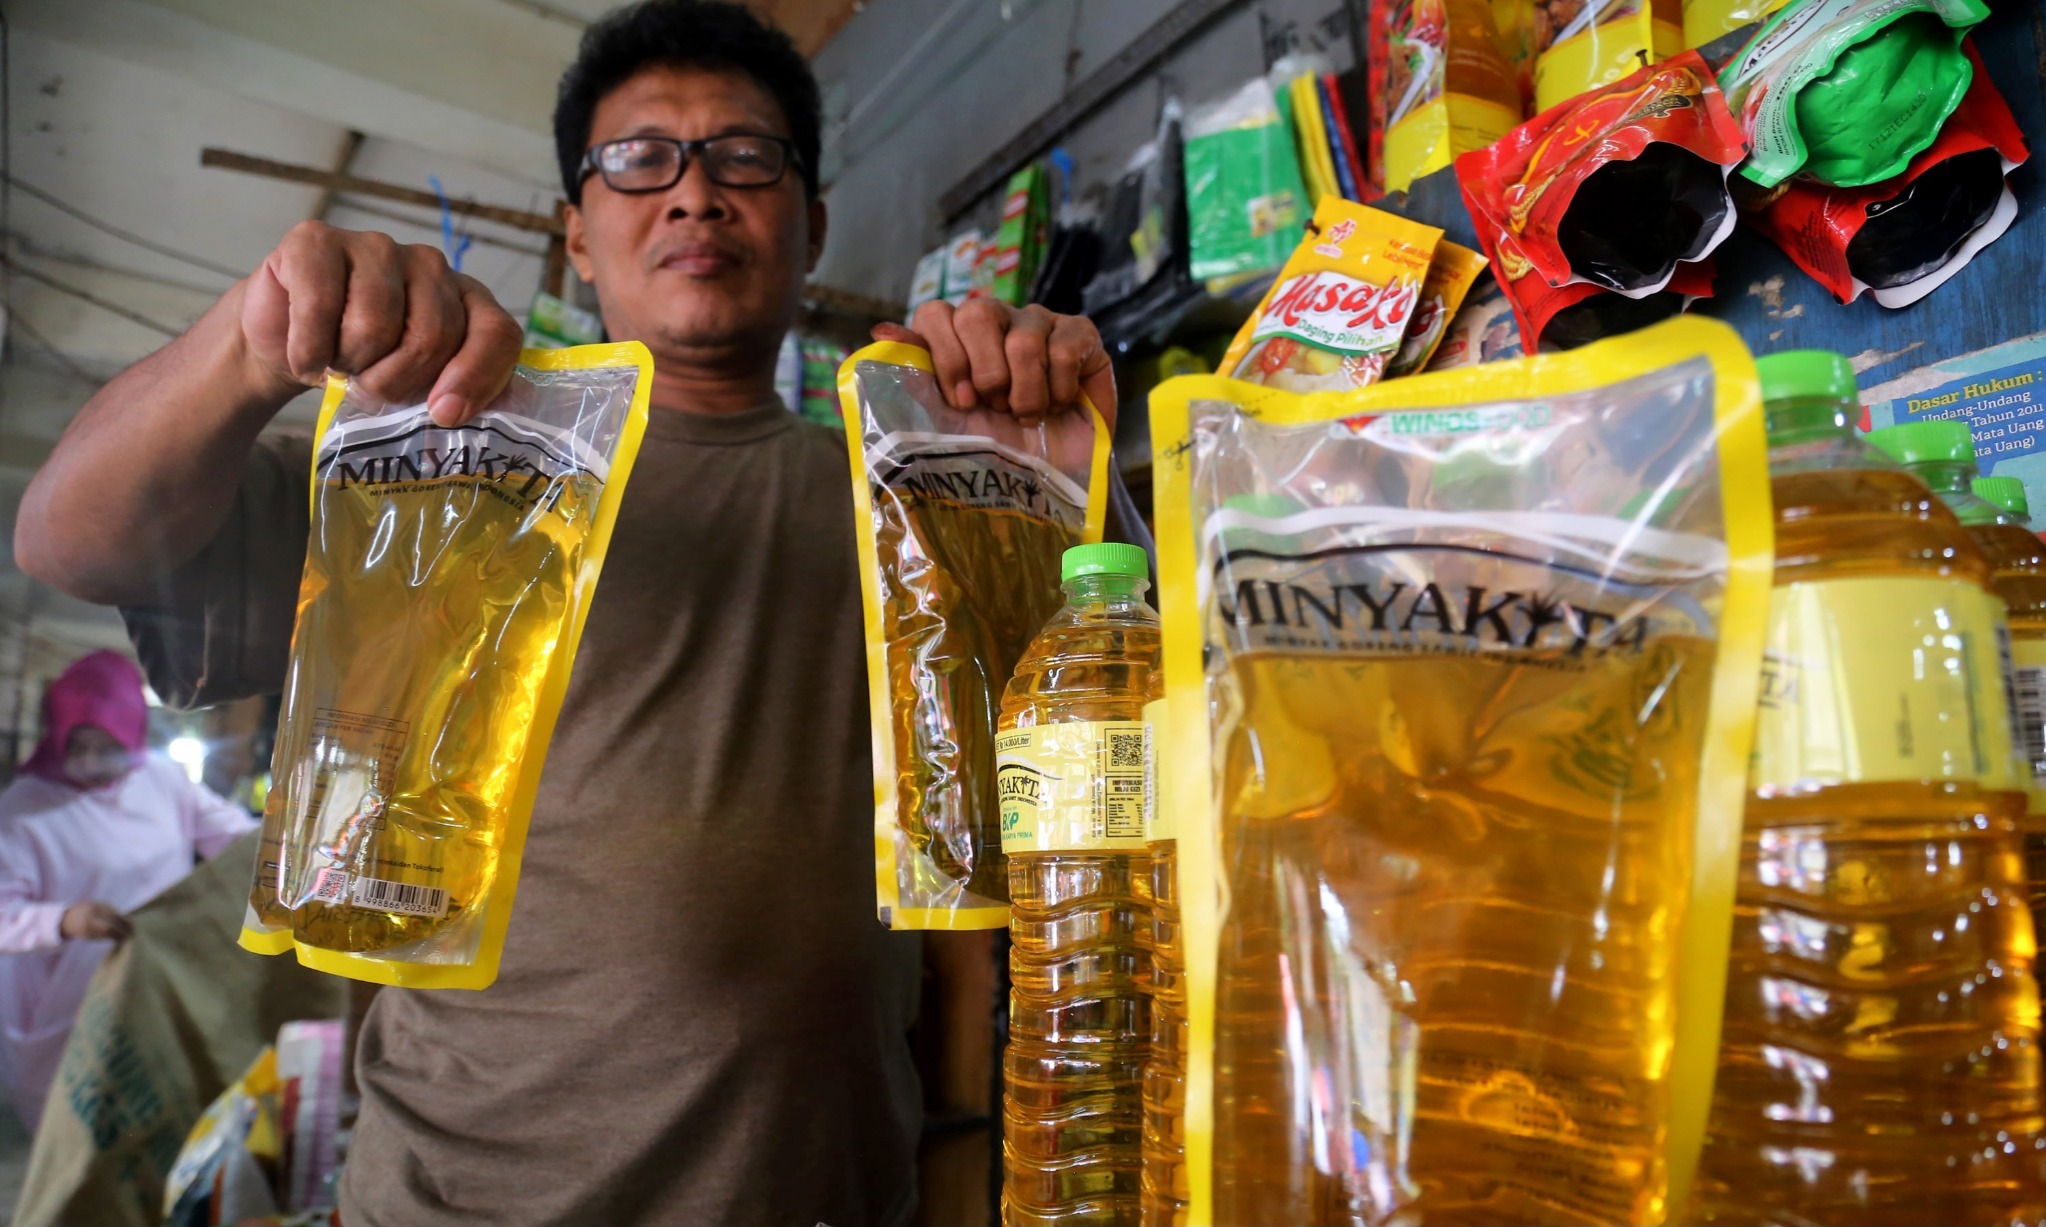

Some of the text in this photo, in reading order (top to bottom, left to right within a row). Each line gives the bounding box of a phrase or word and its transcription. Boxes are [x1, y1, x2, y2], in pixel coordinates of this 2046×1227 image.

[1263, 274, 1413, 330] Masako
[1297, 319, 1384, 347] Daging Pilihan
[1907, 391, 1960, 414] Dasar
[1962, 372, 2034, 400] Hukum
[1922, 391, 2031, 421] Undang-Undang
[1971, 409, 2015, 428] Tahun
[2017, 403, 2044, 417] 2011
[1970, 419, 2044, 443] Mata Uang
[1974, 435, 2035, 458] ata Uang)
[337, 445, 566, 513] MINYAKITA
[370, 484, 408, 497] MINYAK
[1002, 811, 1019, 832] BKP
[355, 895, 438, 914] 8 998866 203654
